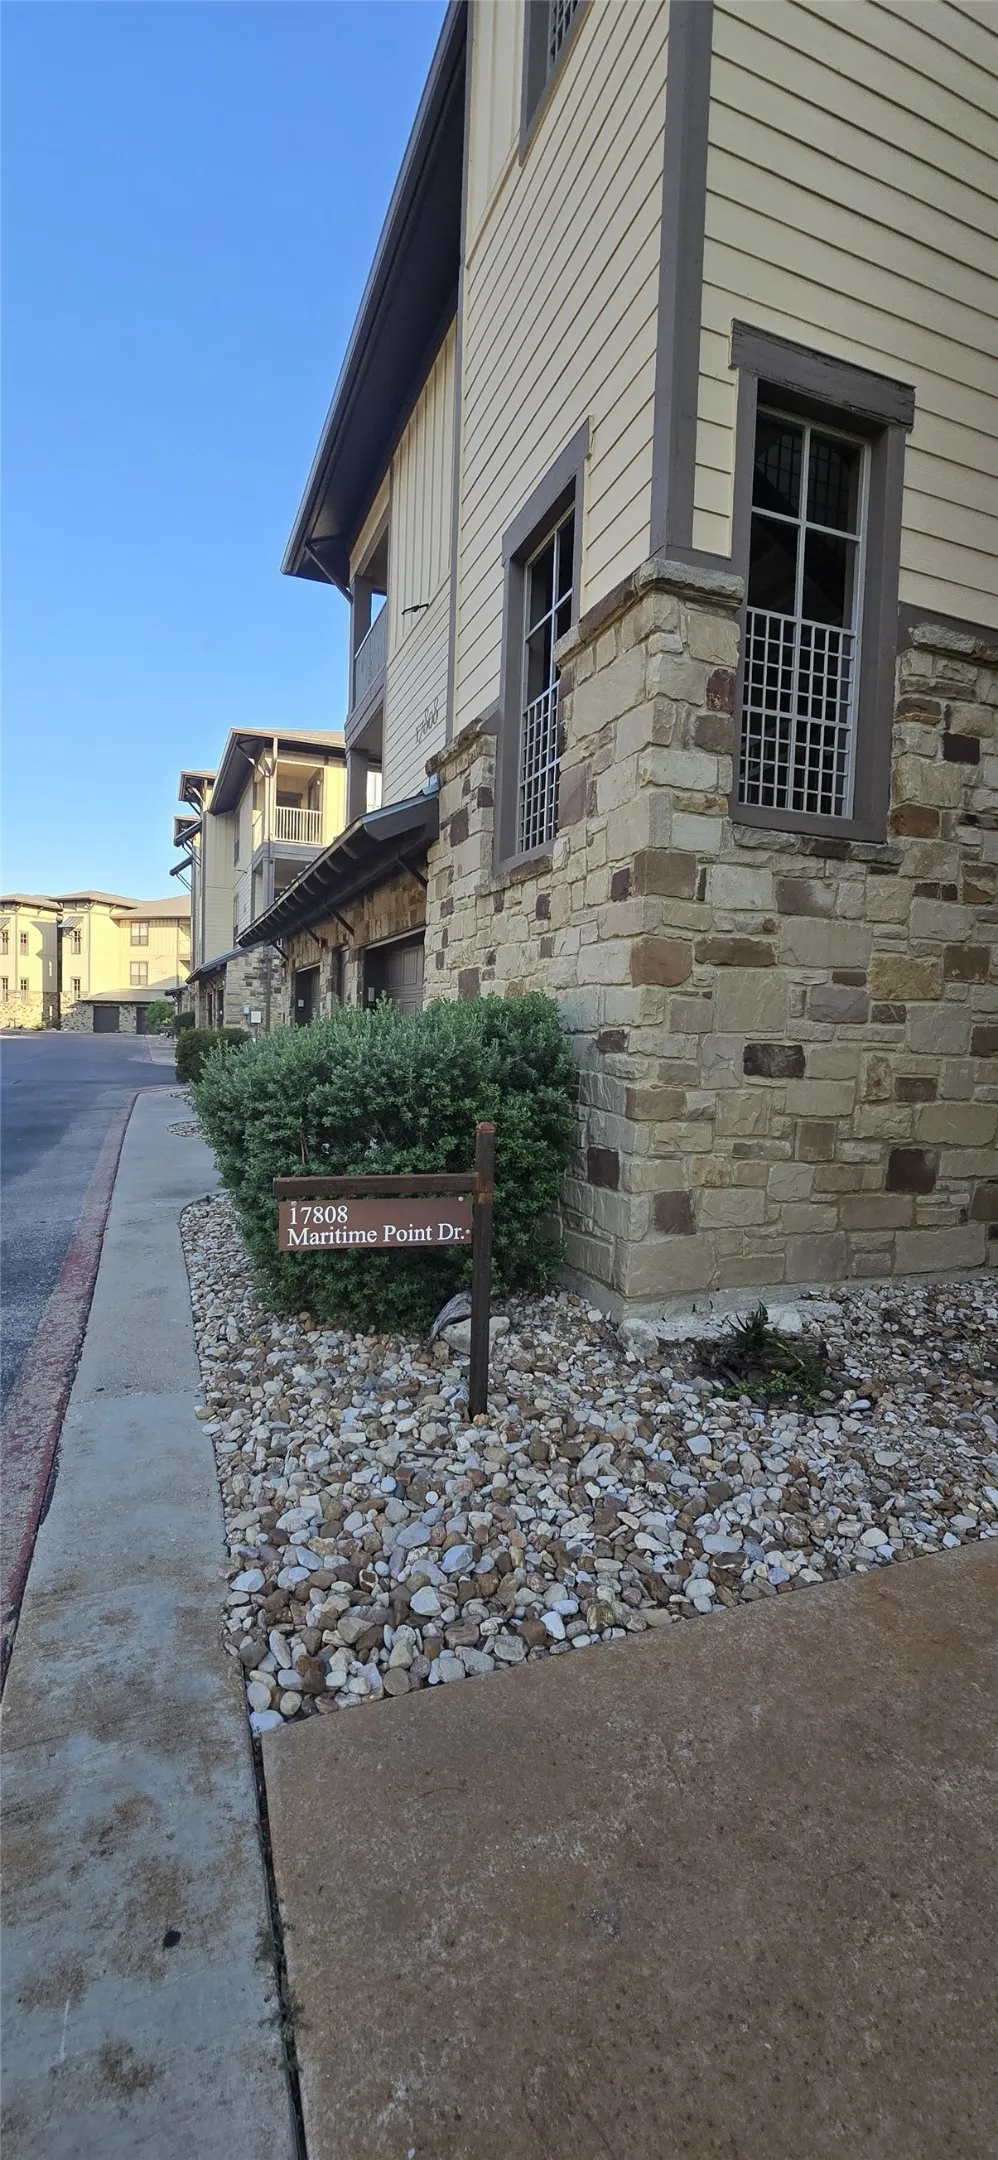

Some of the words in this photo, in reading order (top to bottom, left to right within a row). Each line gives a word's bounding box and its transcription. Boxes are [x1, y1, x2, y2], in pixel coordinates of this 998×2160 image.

[289, 1206, 348, 1225] 17808
[287, 1226, 377, 1246] Maritime
[383, 1224, 432, 1242] Point
[437, 1223, 465, 1240] Dr.
